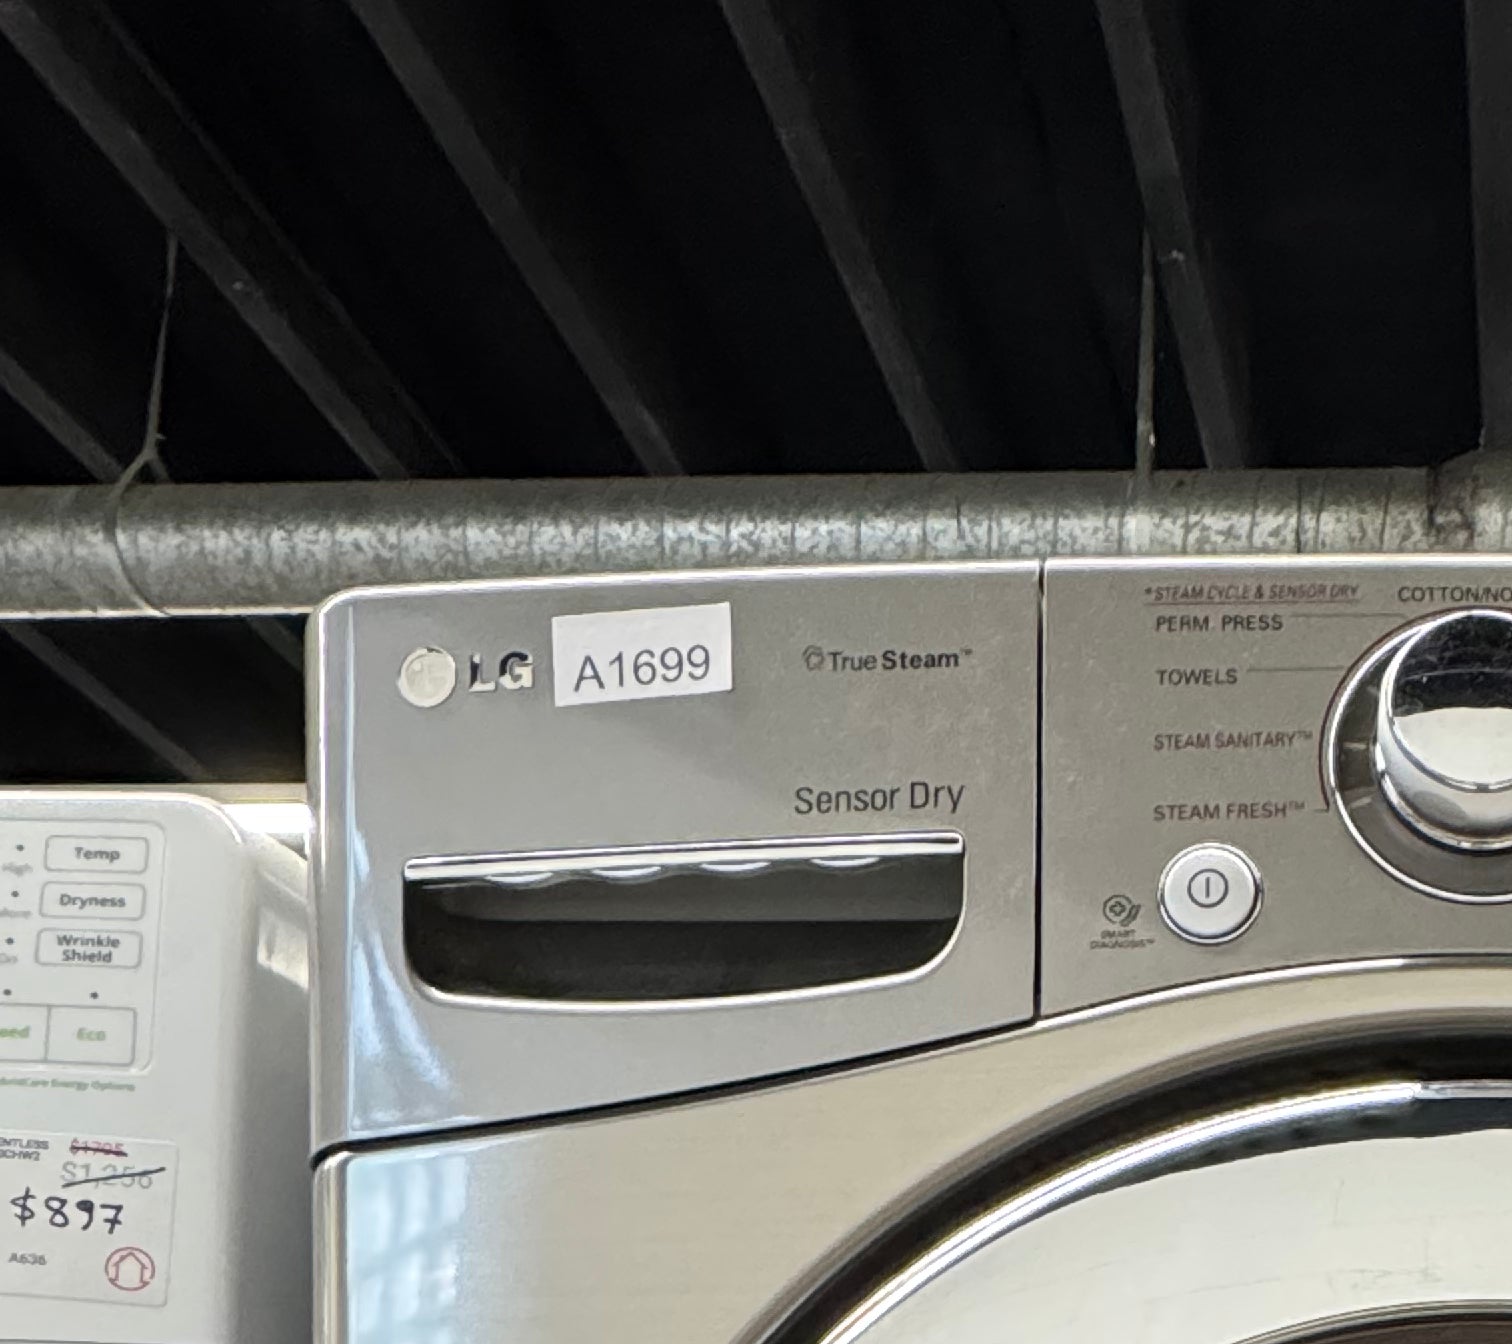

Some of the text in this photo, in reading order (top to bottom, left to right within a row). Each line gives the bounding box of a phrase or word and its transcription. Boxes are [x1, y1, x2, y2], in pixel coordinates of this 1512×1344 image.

[1330, 584, 1360, 599] DRY
[1155, 614, 1284, 632] PERM PRESS
[468, 651, 533, 693] LG
[573, 644, 710, 693] A1699
[1156, 668, 1238, 686] TOWELS
[1154, 733, 1210, 750] STEAM
[794, 781, 966, 815] Sensor Dry
[1153, 804, 1220, 822] STEAM
[74, 846, 121, 864] Temp
[59, 893, 126, 910] Dryness
[57, 935, 121, 949] Wrinkle
[62, 948, 112, 963] Shield
[10, 1186, 124, 1234] $897
